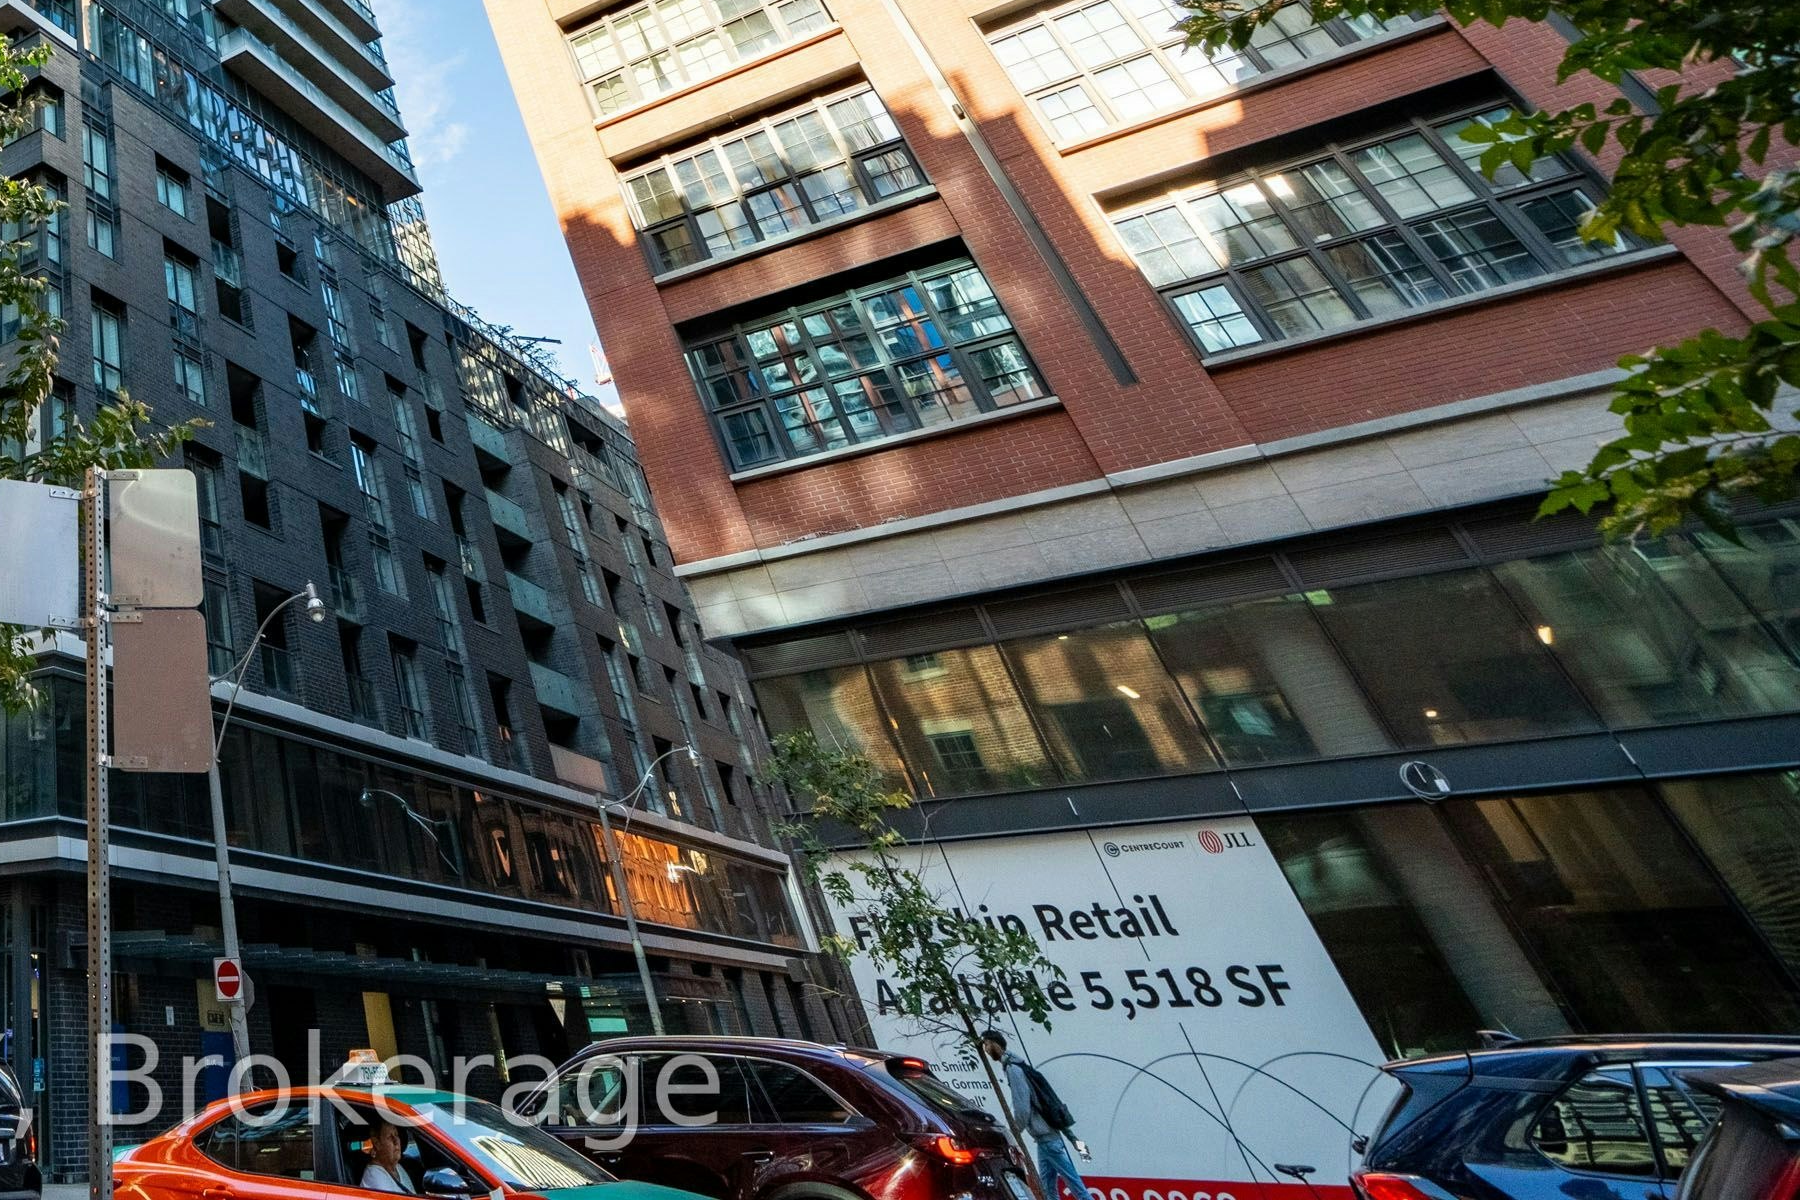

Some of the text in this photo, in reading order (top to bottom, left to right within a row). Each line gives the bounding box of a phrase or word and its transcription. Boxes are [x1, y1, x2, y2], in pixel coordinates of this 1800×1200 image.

[1222, 831, 1256, 849] JLL
[1032, 895, 1179, 942] Retail
[1080, 966, 1222, 1020] 5,518
[1227, 963, 1292, 1007] SF
